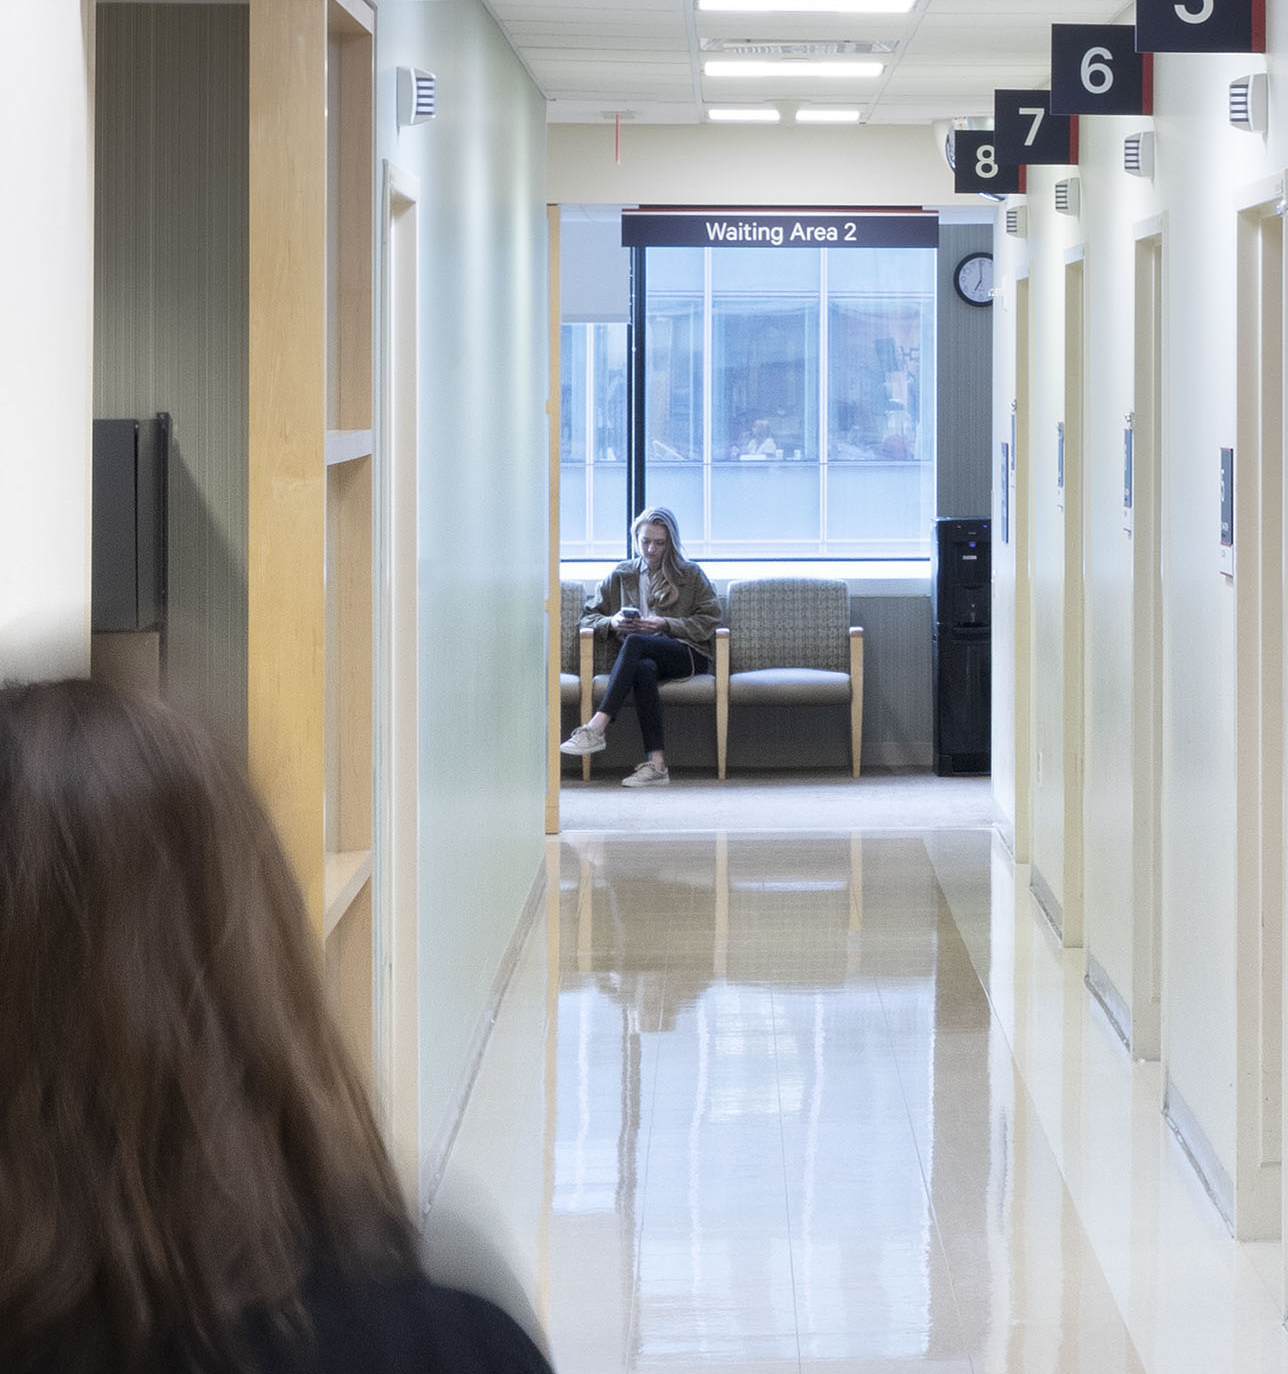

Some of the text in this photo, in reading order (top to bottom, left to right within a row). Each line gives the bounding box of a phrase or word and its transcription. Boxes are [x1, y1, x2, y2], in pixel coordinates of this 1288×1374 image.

[1080, 46, 1114, 95] 6
[1018, 107, 1045, 147] 7
[975, 144, 998, 179] 8
[706, 222, 857, 244] Waiting Area 2
